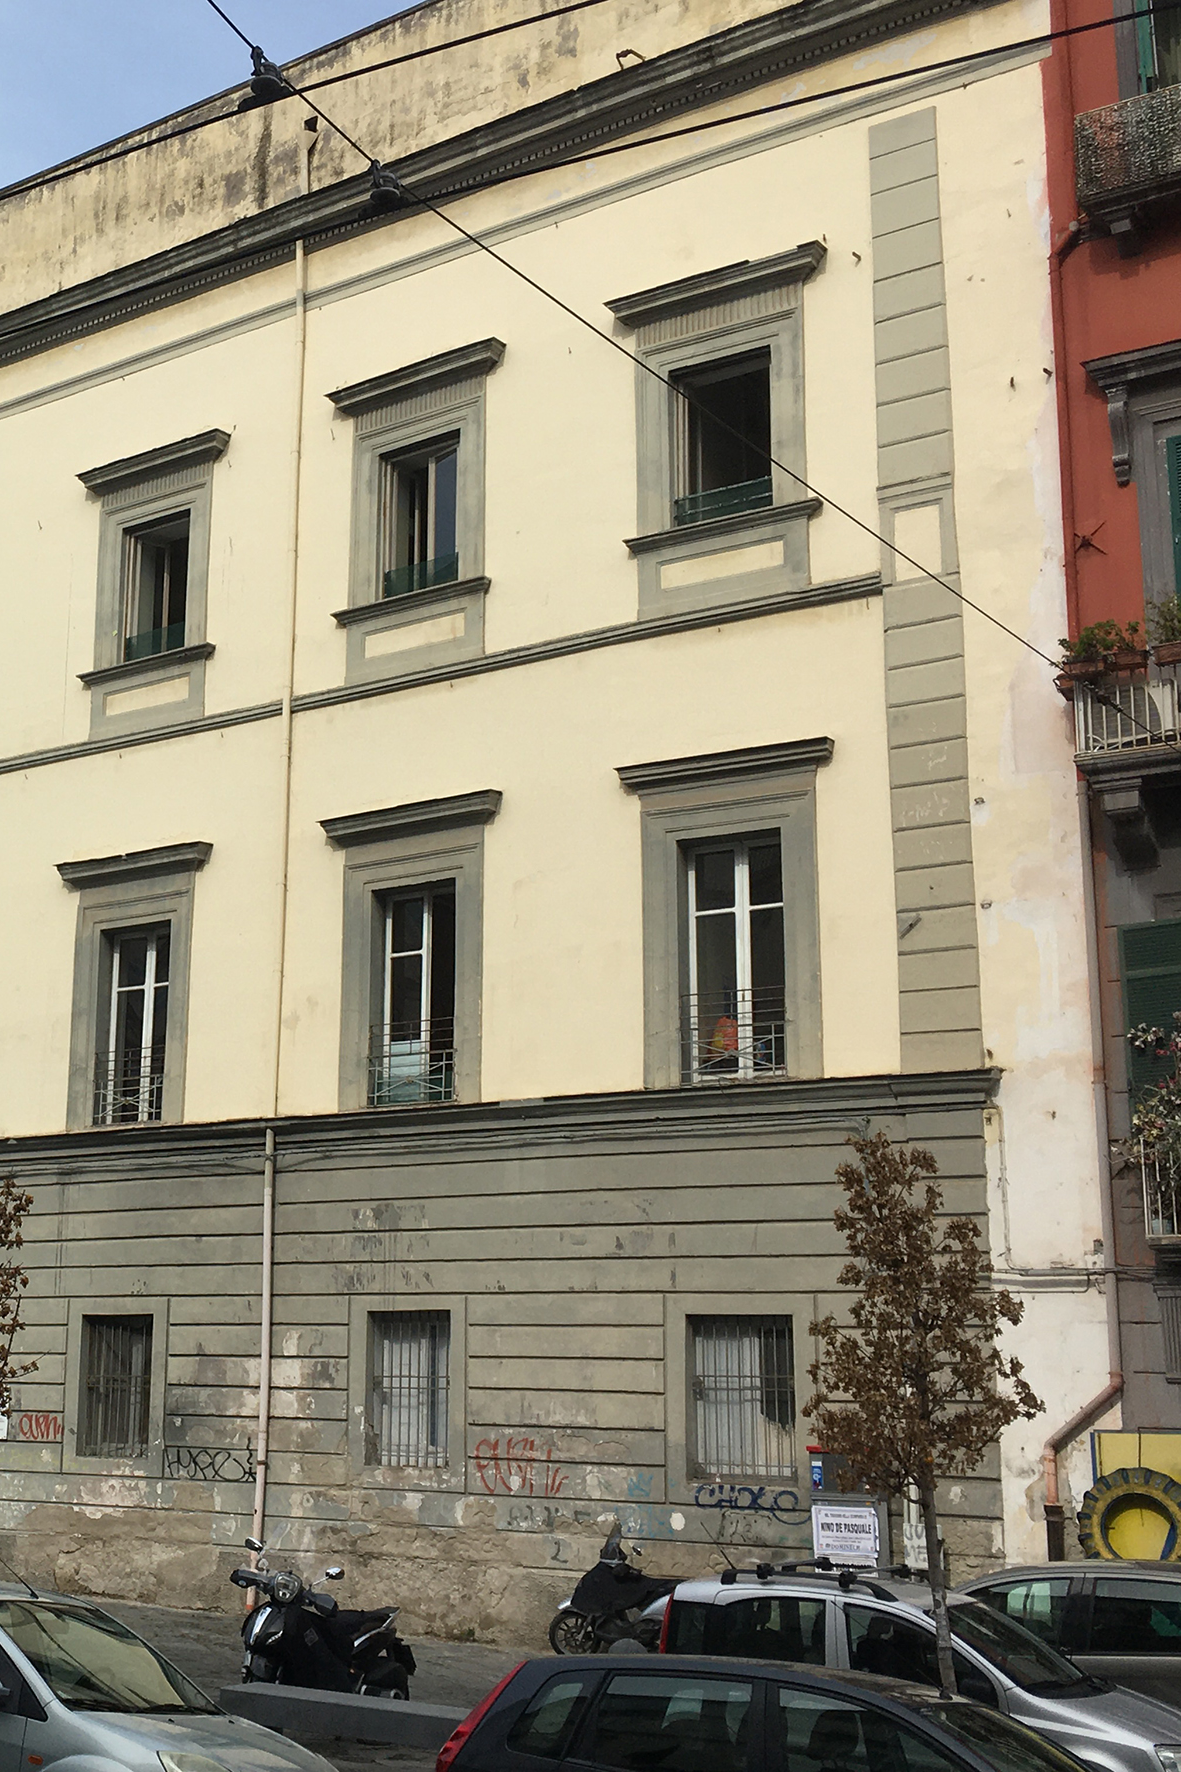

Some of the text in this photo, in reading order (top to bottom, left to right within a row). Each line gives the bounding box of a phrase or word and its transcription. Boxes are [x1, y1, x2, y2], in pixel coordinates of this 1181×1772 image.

[821, 1522, 872, 1534] NINO DE PASQUALE
